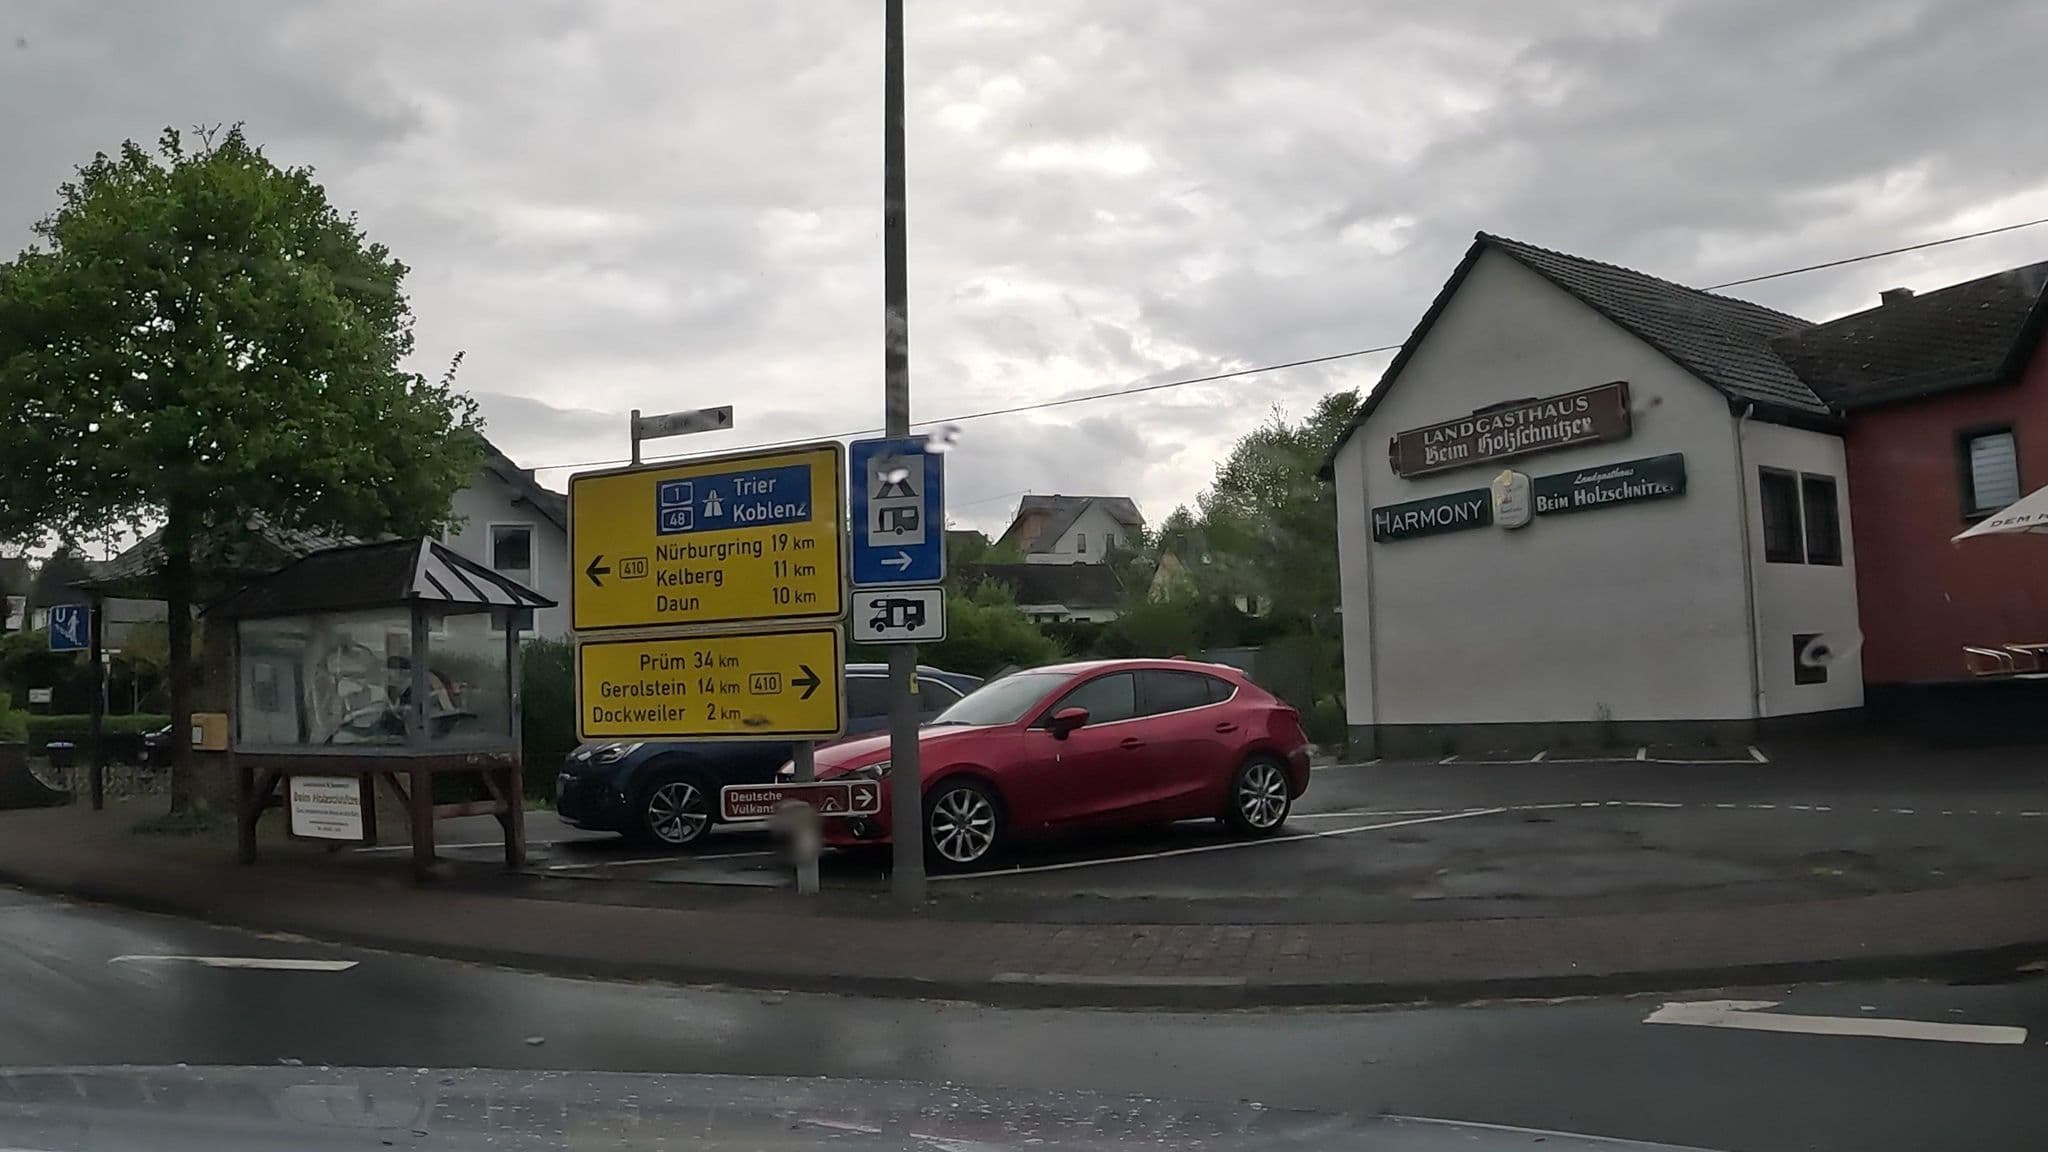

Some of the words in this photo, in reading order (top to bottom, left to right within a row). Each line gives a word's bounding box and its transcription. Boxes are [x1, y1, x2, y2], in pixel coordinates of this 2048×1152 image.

[1423, 395, 1590, 446] LANDGASTHAUS
[1424, 441, 1469, 466] Beim
[674, 487, 680, 501] 1
[733, 477, 776, 496] Trier
[669, 512, 685, 526] 48
[733, 501, 807, 522] Koblenz
[1375, 500, 1482, 535] HARMONY
[656, 538, 763, 562] Nürburgring
[771, 533, 788, 552] 19
[793, 537, 815, 550] km
[623, 561, 645, 575] 410
[656, 568, 723, 587] Kelberg
[773, 560, 788, 578] 11
[794, 564, 816, 577] km
[656, 595, 700, 612] Daun
[772, 587, 790, 605] 10
[794, 590, 817, 603] km
[56, 608, 66, 622] U
[640, 653, 686, 671] Prüm
[694, 650, 713, 669] 34
[718, 654, 740, 668] km
[601, 678, 687, 698] Gerolstein
[698, 677, 715, 695] 14
[719, 680, 741, 694] km
[753, 676, 777, 691] 410
[592, 704, 686, 723] Dockweiler
[706, 702, 717, 721] 2
[720, 707, 741, 720] km
[730, 791, 783, 802] Deutsche
